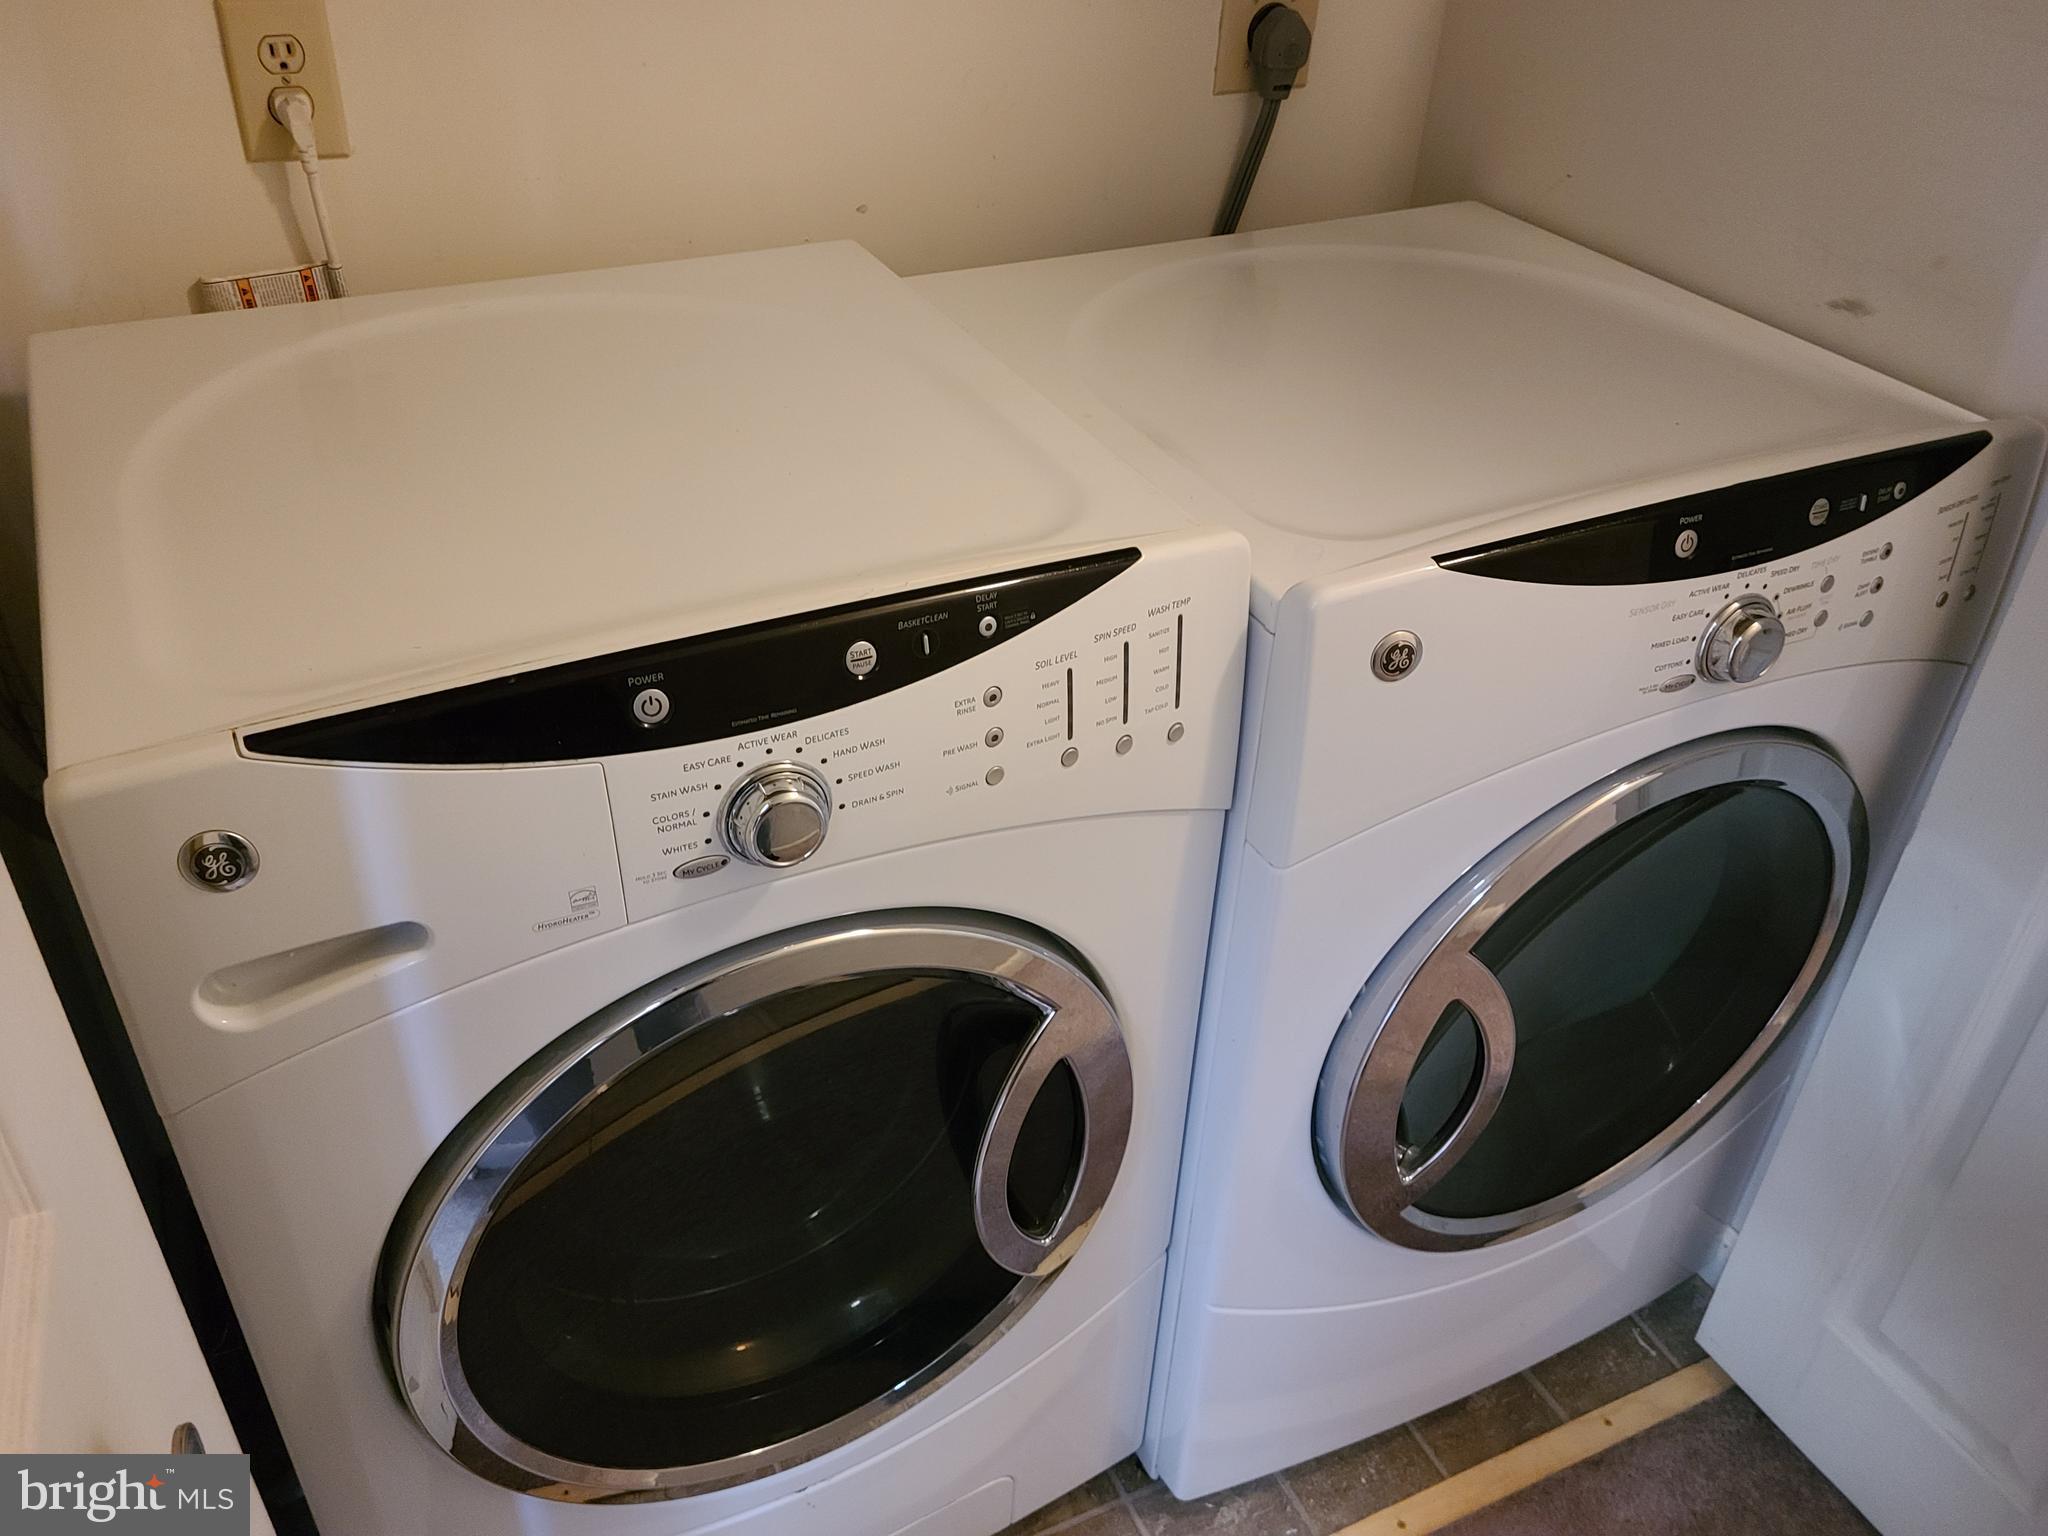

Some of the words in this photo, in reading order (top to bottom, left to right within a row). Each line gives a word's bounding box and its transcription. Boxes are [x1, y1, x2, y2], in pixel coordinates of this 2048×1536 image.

[975, 591, 998, 603] DELAY
[976, 601, 998, 613] START
[1147, 606, 1171, 618] WASH
[1172, 596, 1191, 610] TEMP
[1093, 631, 1112, 643] SPIN
[1113, 623, 1137, 637] SPEED
[849, 648, 872, 659] START
[1035, 658, 1053, 671] SOIL
[1055, 650, 1078, 665] LEVEL
[852, 660, 872, 670] PAUSE
[627, 672, 664, 688] POWER
[954, 696, 976, 708] EXTRA
[956, 705, 976, 716] RINSE
[737, 737, 769, 751] ACTIVE
[770, 730, 799, 744] WEAR
[804, 728, 850, 745] DELICATES
[832, 746, 858, 758] HAND
[859, 737, 886, 751] WASH
[943, 748, 955, 757] PRE
[957, 742, 978, 753] WASH
[683, 760, 706, 772] EASY
[707, 755, 732, 767] CARE
[848, 768, 874, 782] SPEED
[874, 761, 901, 774] WASH
[650, 790, 678, 802] STAIN
[679, 782, 708, 795] WASH
[955, 780, 979, 792] SIGNAL
[851, 795, 878, 809] DRAIN
[886, 787, 905, 799] SPIN
[652, 810, 690, 825] COLORS
[657, 820, 698, 834] NORMAL
[661, 841, 698, 856] WHITES
